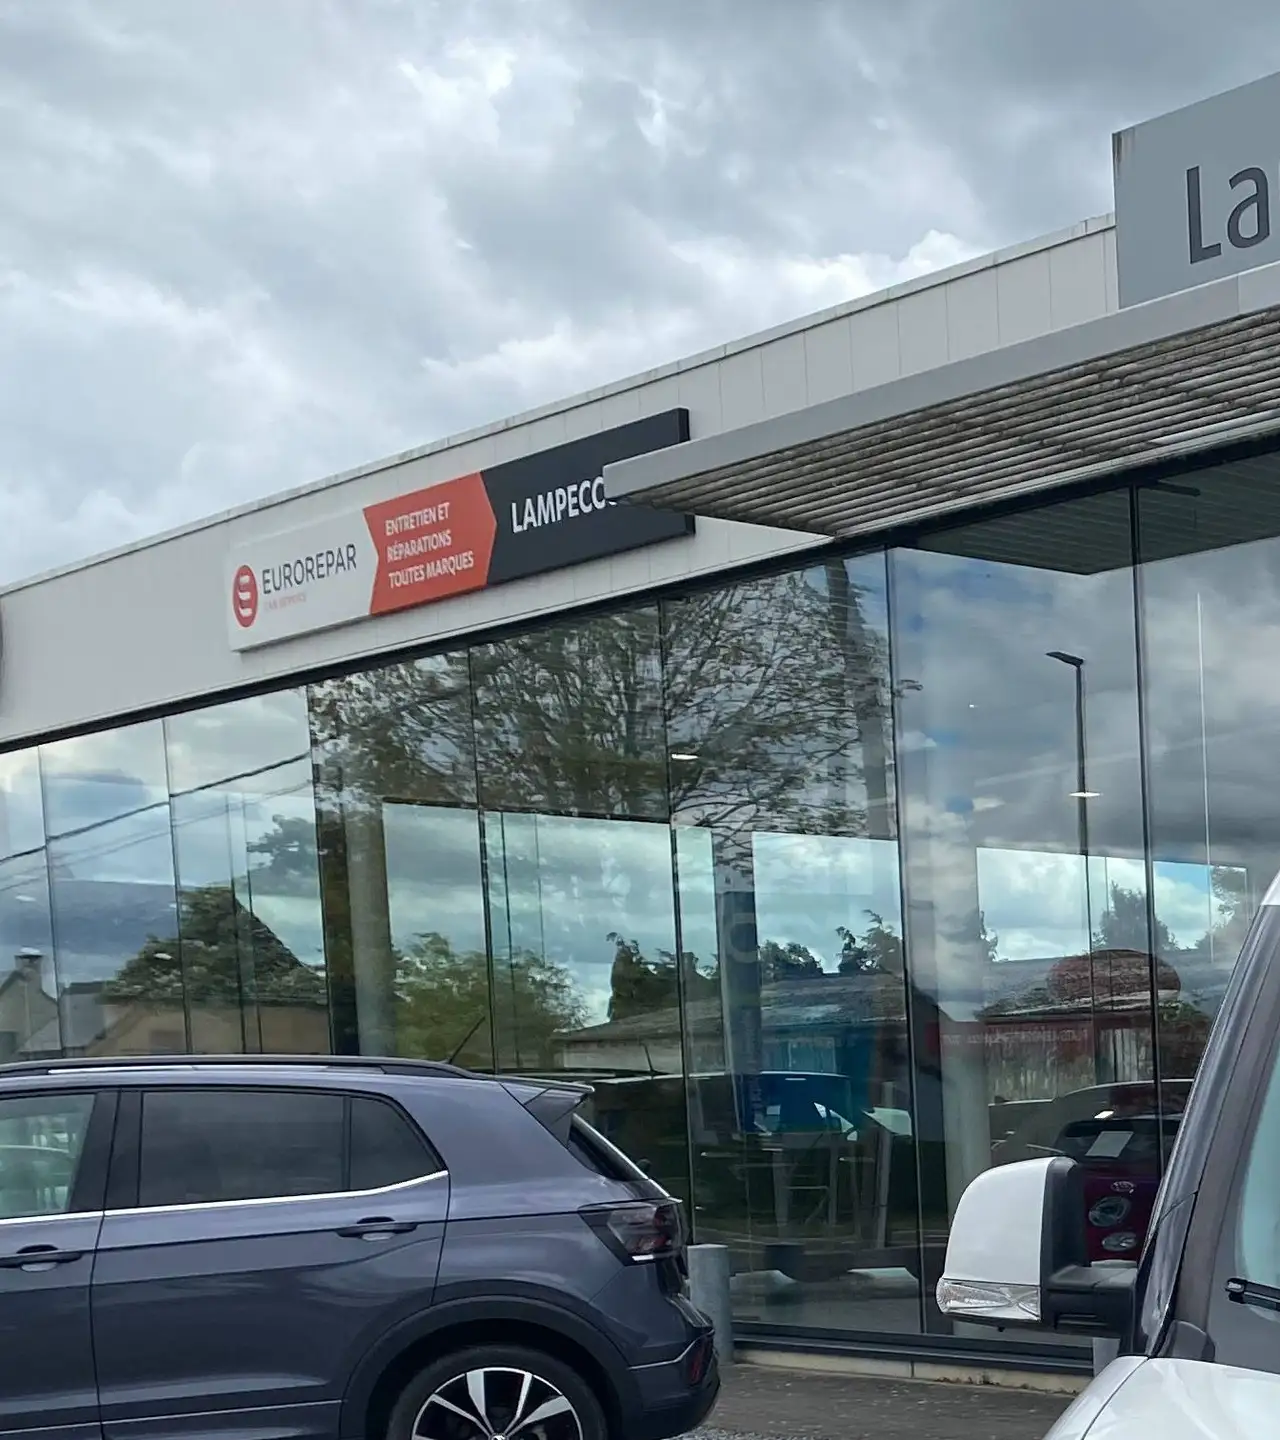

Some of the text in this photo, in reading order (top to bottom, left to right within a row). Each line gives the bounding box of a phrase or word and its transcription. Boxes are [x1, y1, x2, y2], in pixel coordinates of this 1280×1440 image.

[385, 502, 450, 536] ENTRETIEN ET
[511, 476, 617, 533] LAMPECC
[386, 529, 452, 563] RÉPARATIONS
[262, 543, 357, 595] EUROREPAR
[388, 550, 474, 589] TOUTES MARQUES
